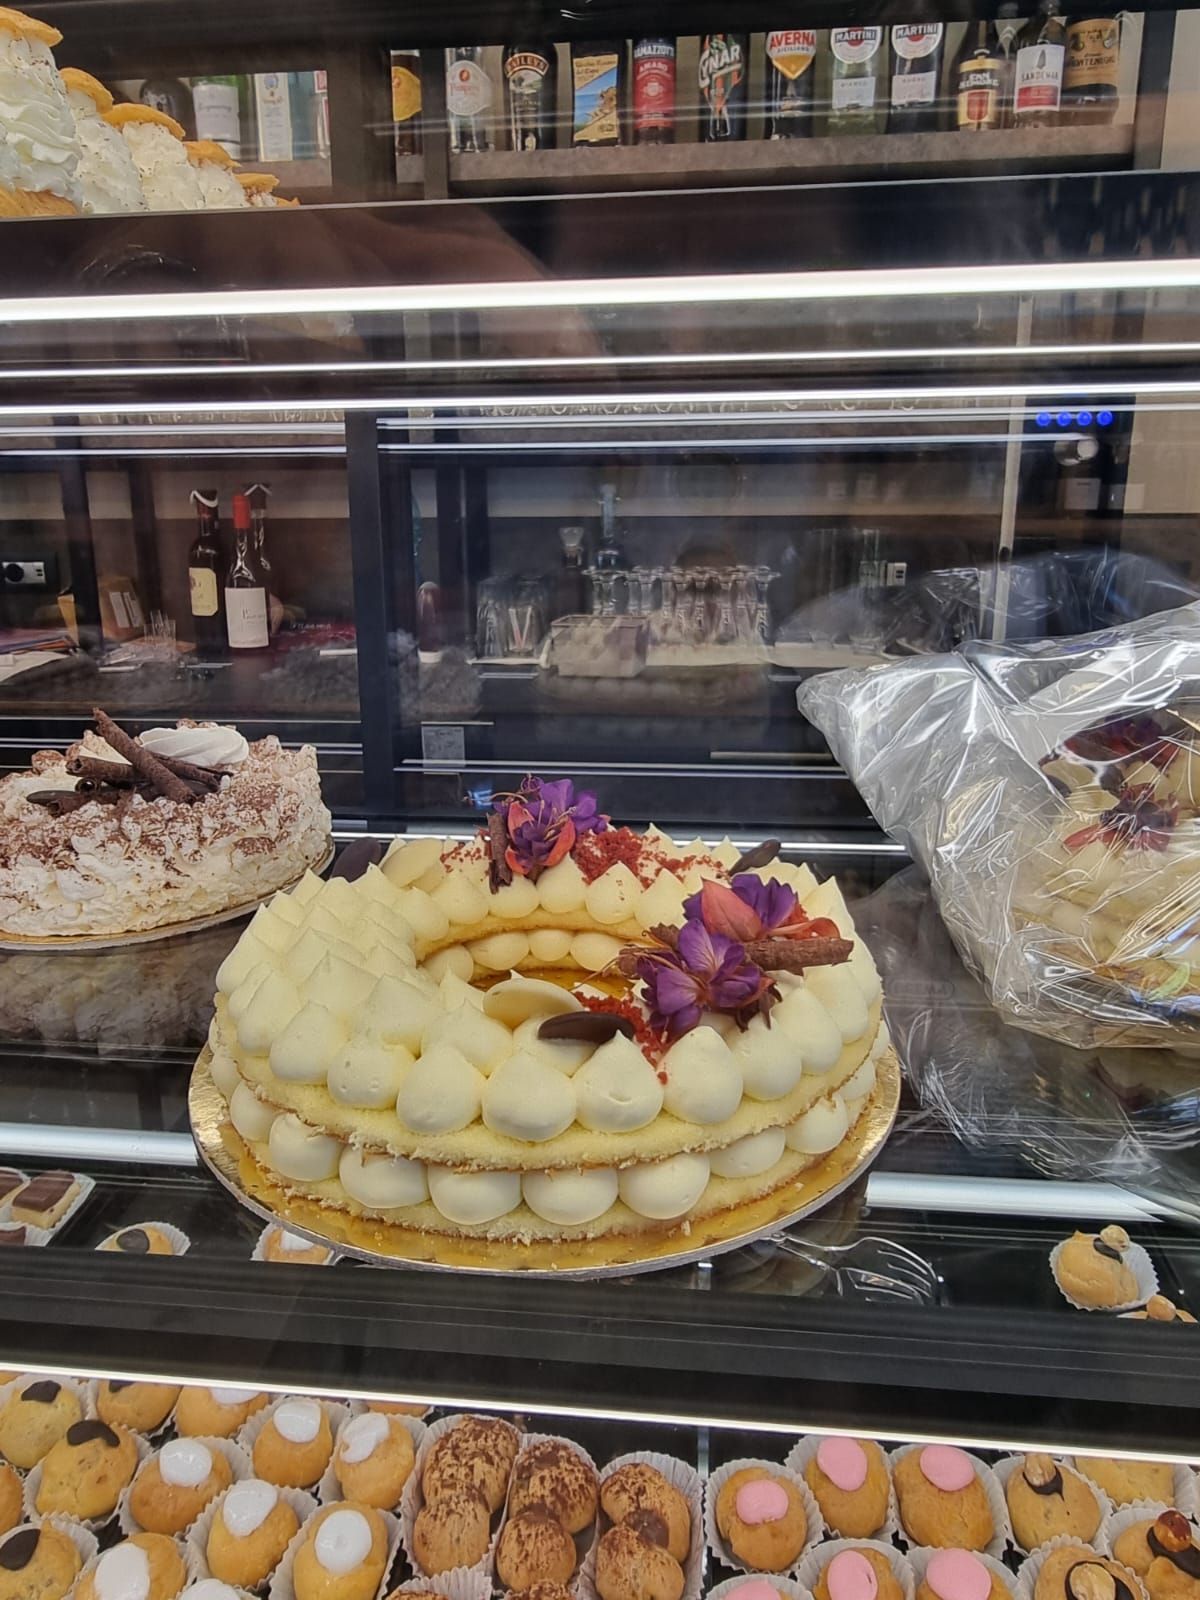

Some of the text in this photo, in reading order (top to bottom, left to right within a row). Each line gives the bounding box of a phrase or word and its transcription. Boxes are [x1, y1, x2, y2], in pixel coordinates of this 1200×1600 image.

[836, 31, 876, 42] MARTINI
[896, 24, 938, 38] MARTINI
[770, 32, 815, 50] AVERNA
